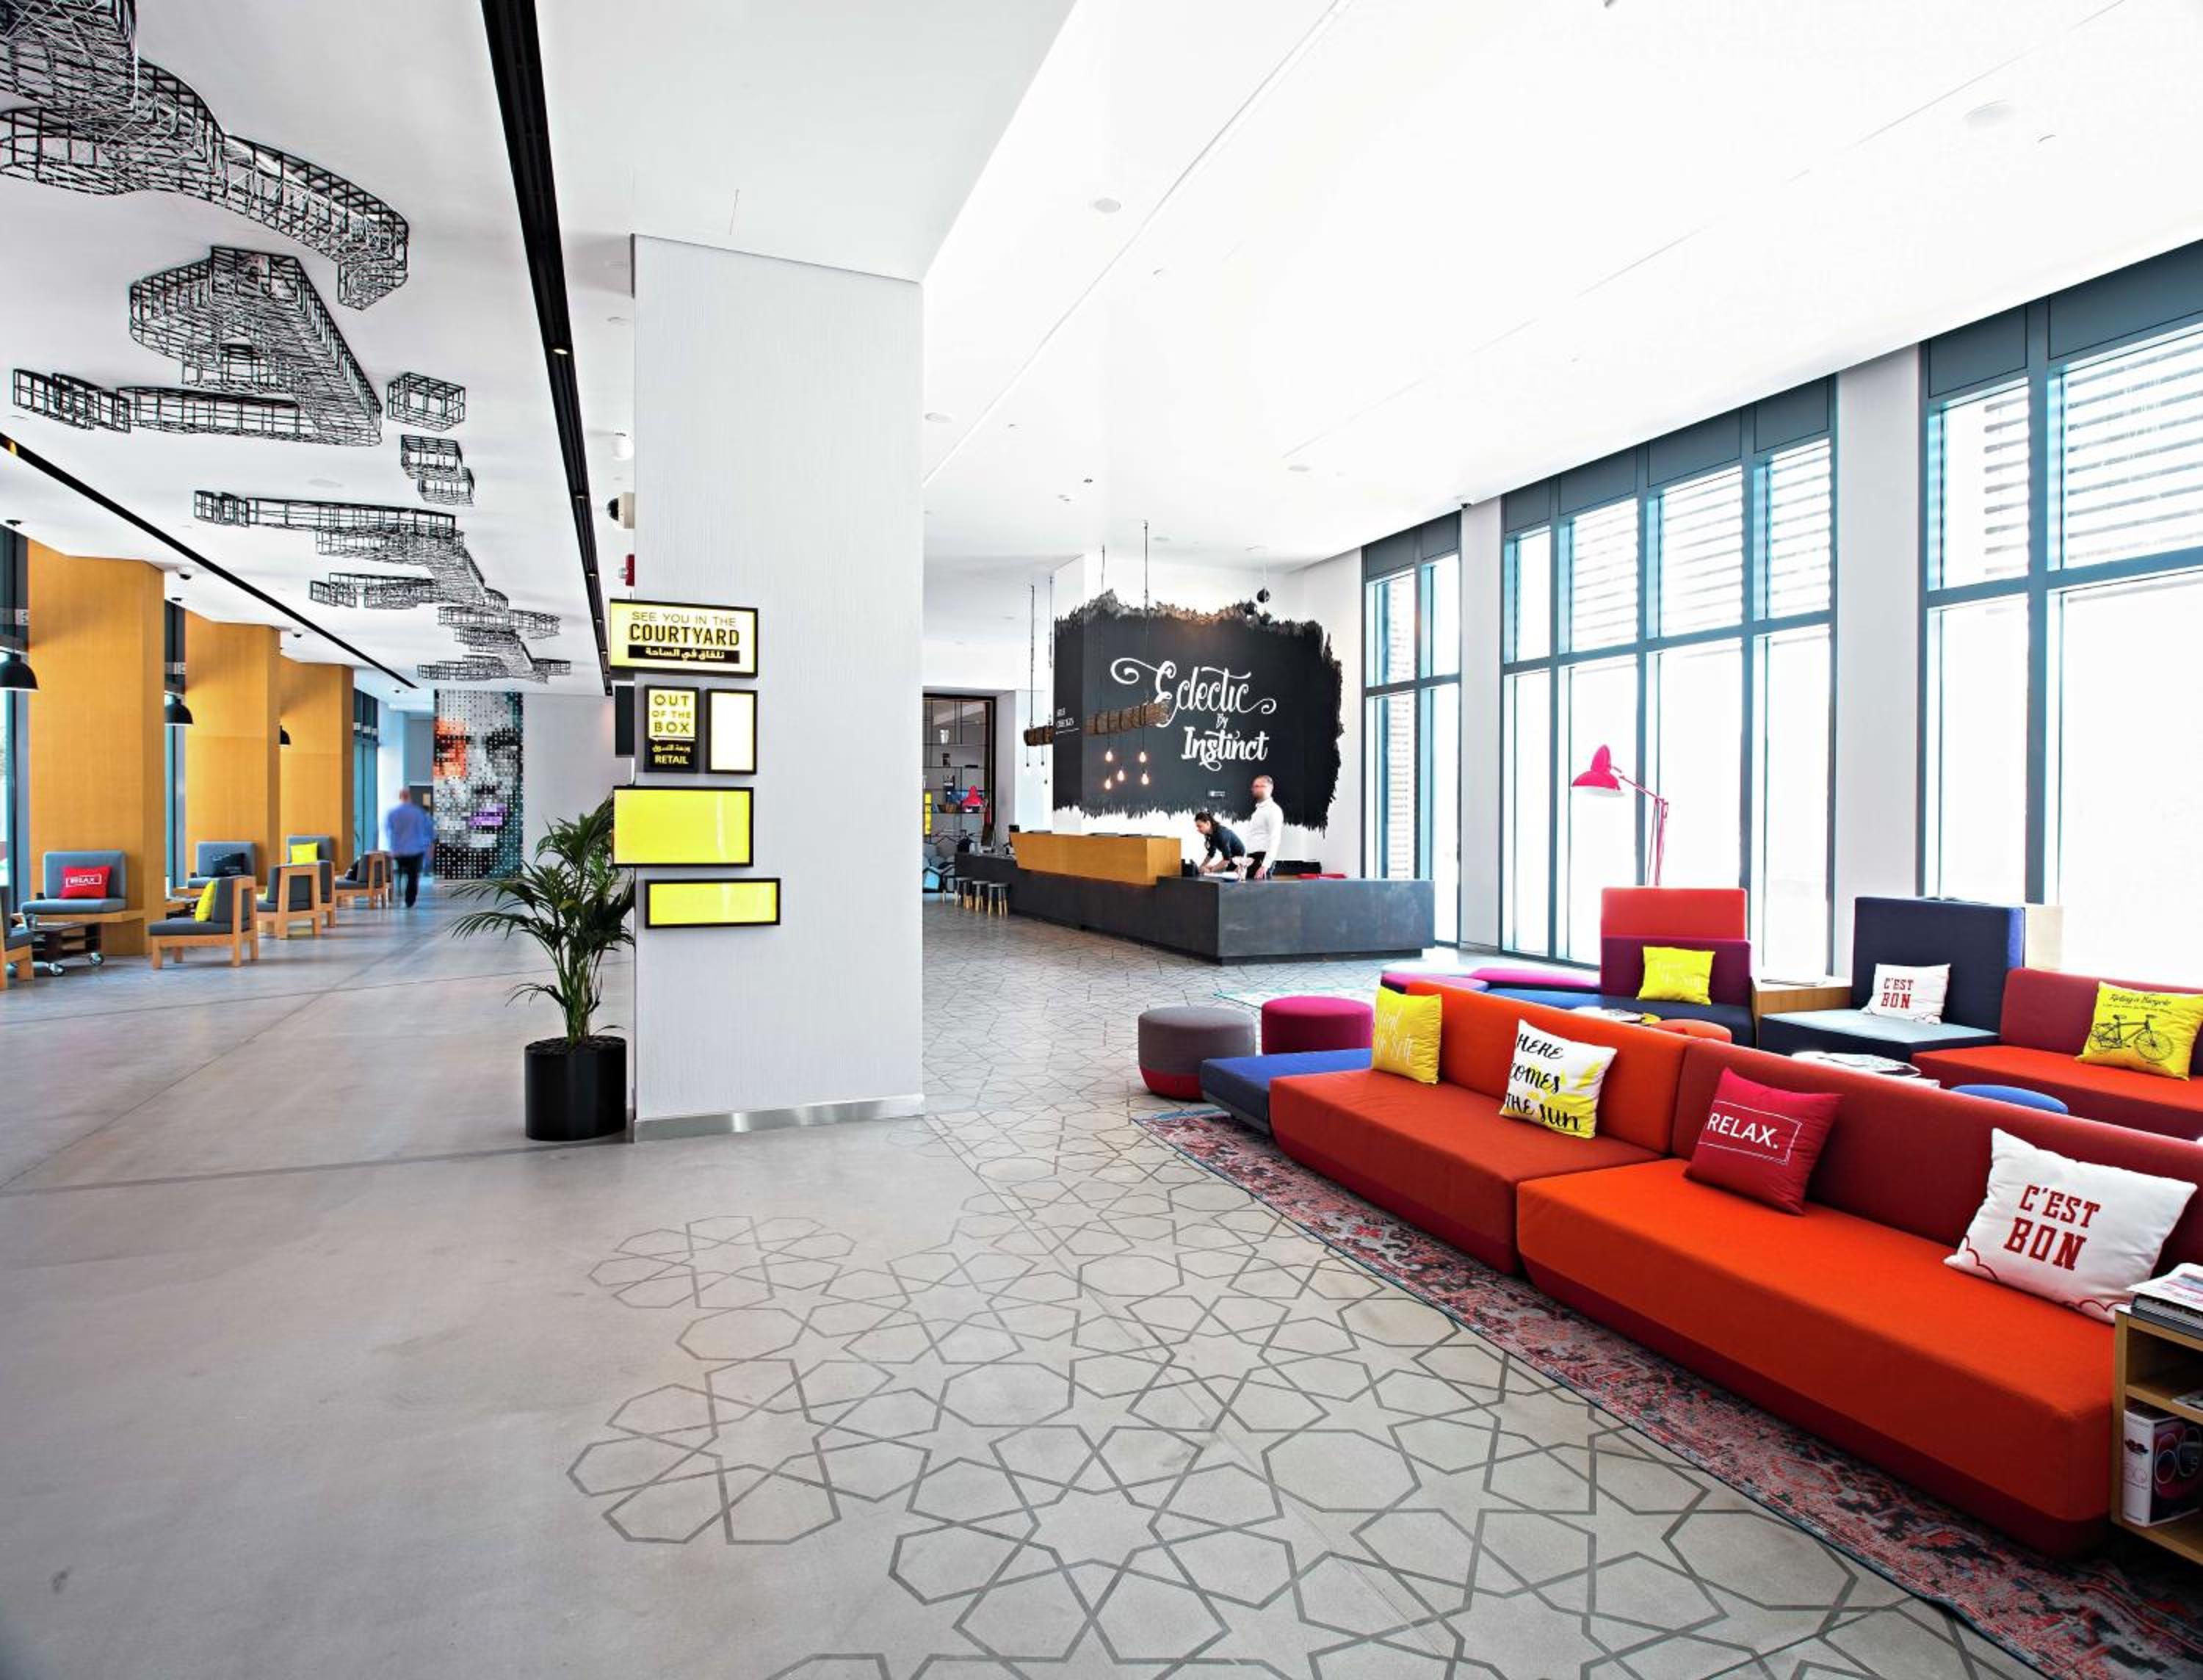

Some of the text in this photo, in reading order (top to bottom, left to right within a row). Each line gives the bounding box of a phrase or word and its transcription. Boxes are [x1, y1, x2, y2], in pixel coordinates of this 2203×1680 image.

[632, 611, 736, 626] SEE YOU IN THE
[629, 623, 739, 646] COURTYARD
[654, 694, 690, 706] OUT
[1110, 657, 1277, 728] Eclectic
[671, 710, 691, 719] THE
[654, 721, 689, 734] BOX
[654, 754, 689, 764] RETAIL
[1181, 725, 1270, 771] Instinct
[1884, 977, 1914, 991] C'EST
[1881, 992, 1911, 1009] BON
[1517, 1034, 1563, 1059] HERE
[1506, 1093, 1535, 1115] THE
[1707, 1112, 1779, 1150] RELAX.
[2019, 1184, 2101, 1228] C'EST
[2003, 1217, 2087, 1271] BON
